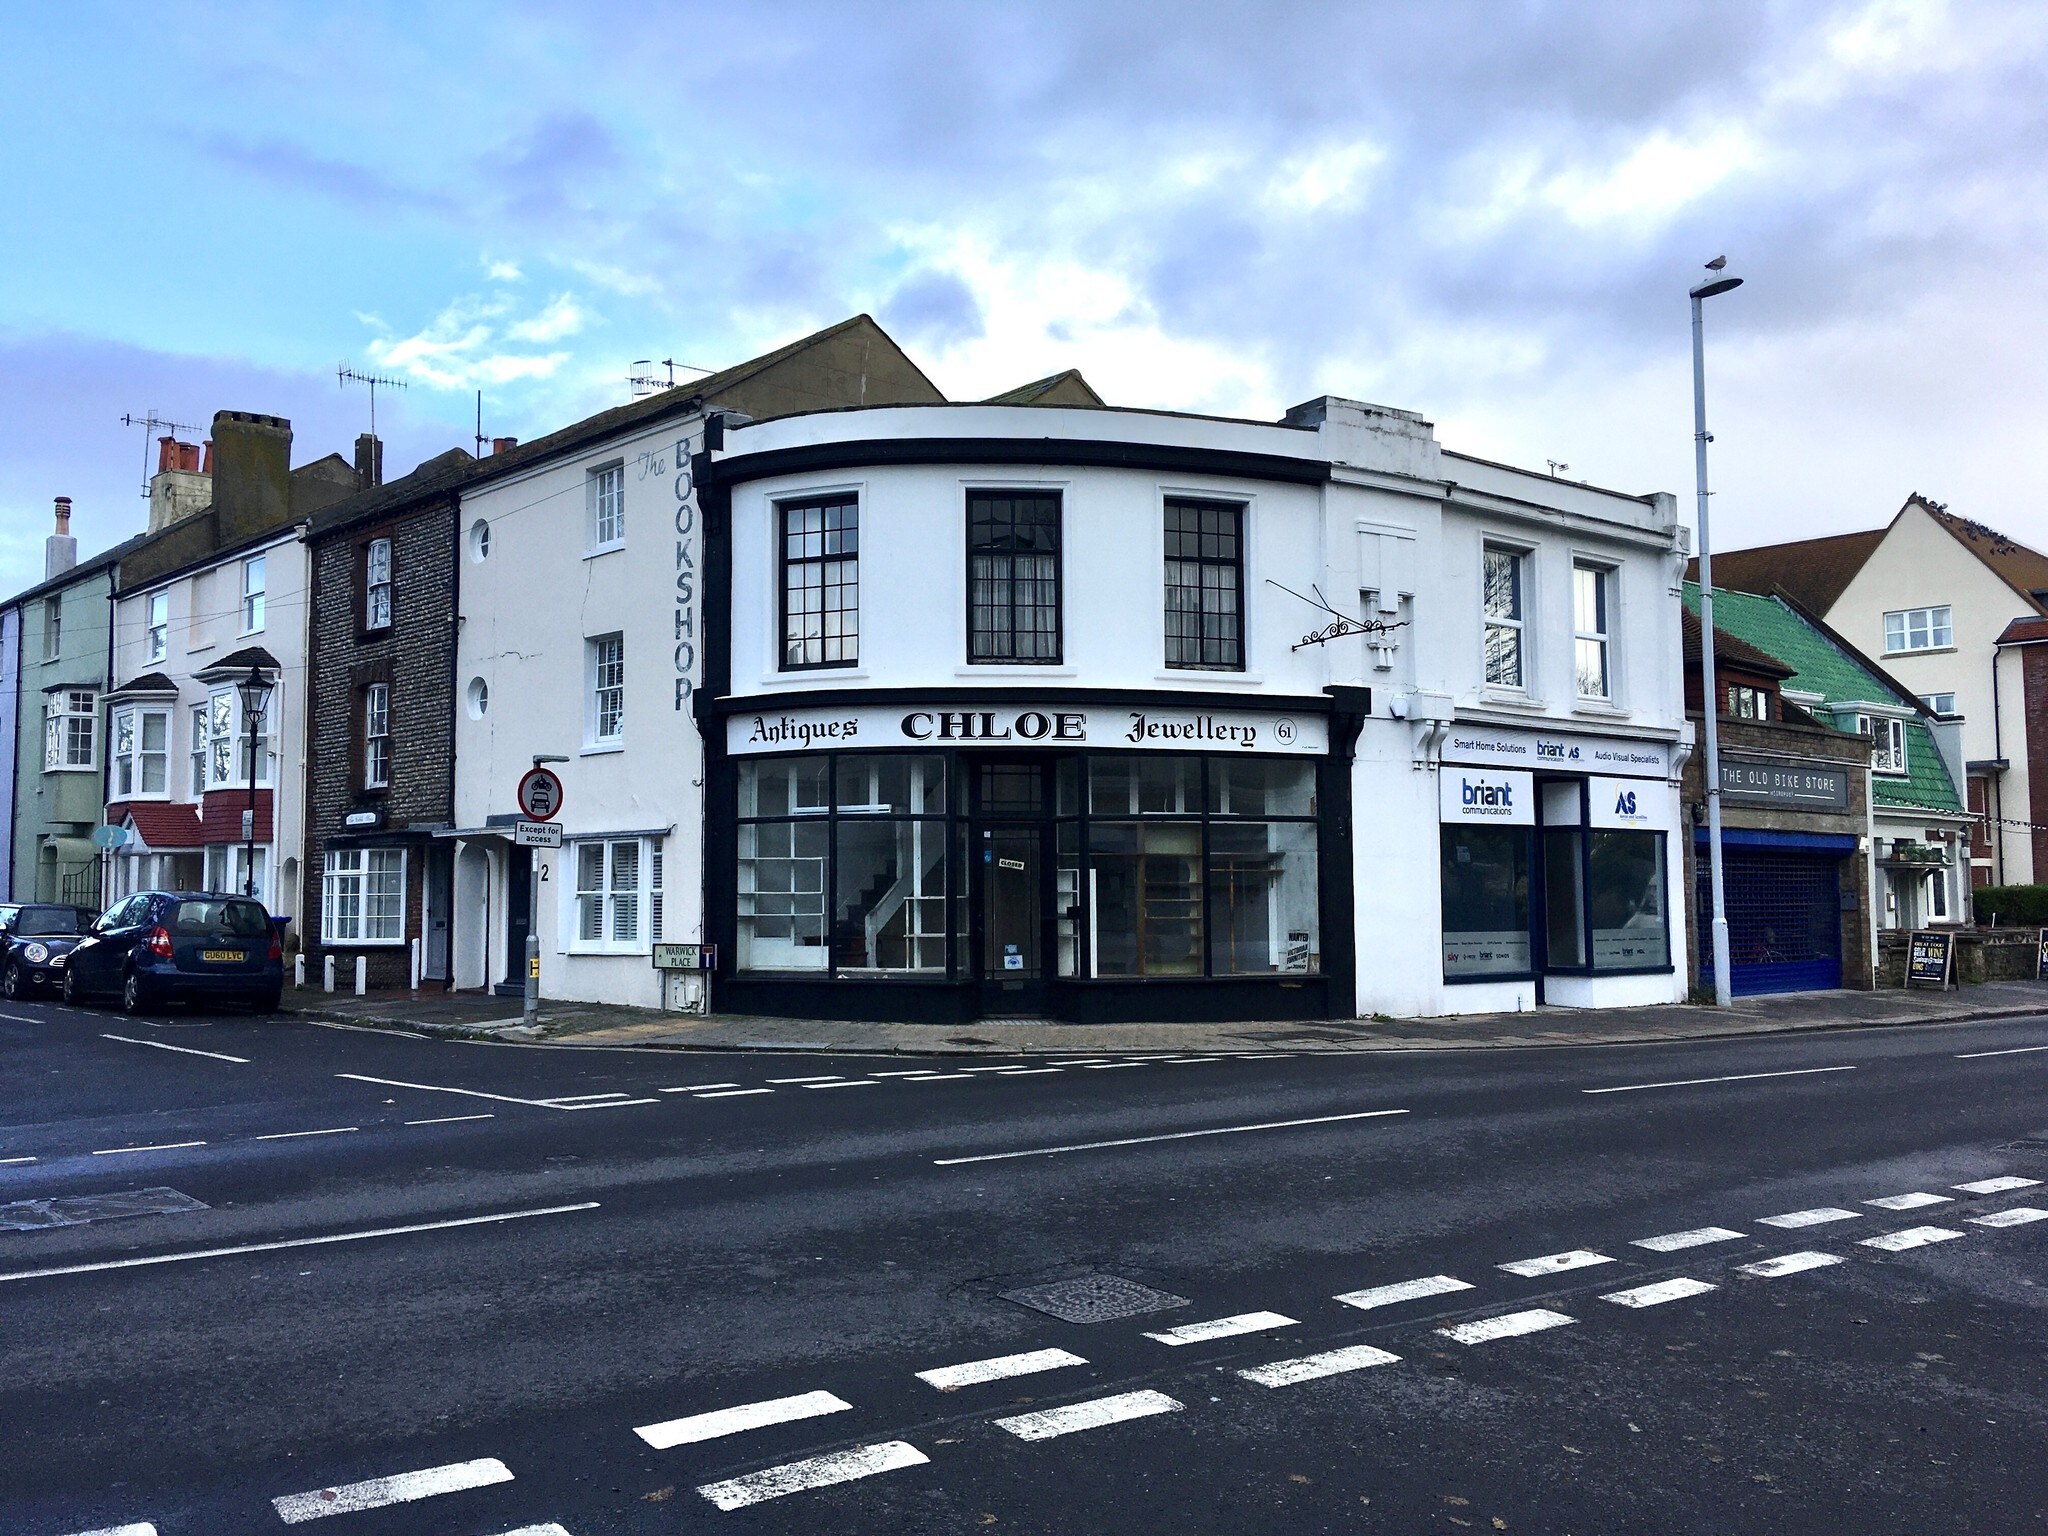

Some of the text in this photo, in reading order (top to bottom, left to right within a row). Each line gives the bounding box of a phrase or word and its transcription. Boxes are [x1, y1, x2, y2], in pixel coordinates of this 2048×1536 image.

[638, 452, 666, 481] The
[674, 437, 694, 711] BOOKSHOP
[749, 715, 858, 748] Antiques
[901, 712, 1087, 741] CHLOE
[1125, 712, 1257, 748] Jewellery
[1277, 723, 1292, 738] 61
[1454, 738, 1526, 754] Smart Home Solutions
[1537, 740, 1565, 758] briant
[1594, 751, 1660, 765] Audio Visual Specialists
[1722, 768, 1835, 792] THE OLD BIKE STORE
[1462, 777, 1513, 807] briant
[1462, 806, 1512, 815] communications
[520, 824, 559, 835] Except for
[526, 835, 551, 843] access
[1001, 860, 1022, 868] CLOSED
[541, 864, 549, 881] 2
[1289, 933, 1308, 941] WANTED
[665, 946, 697, 956] WARWICK
[1447, 951, 1459, 963] sky
[671, 957, 691, 967] PLACE
